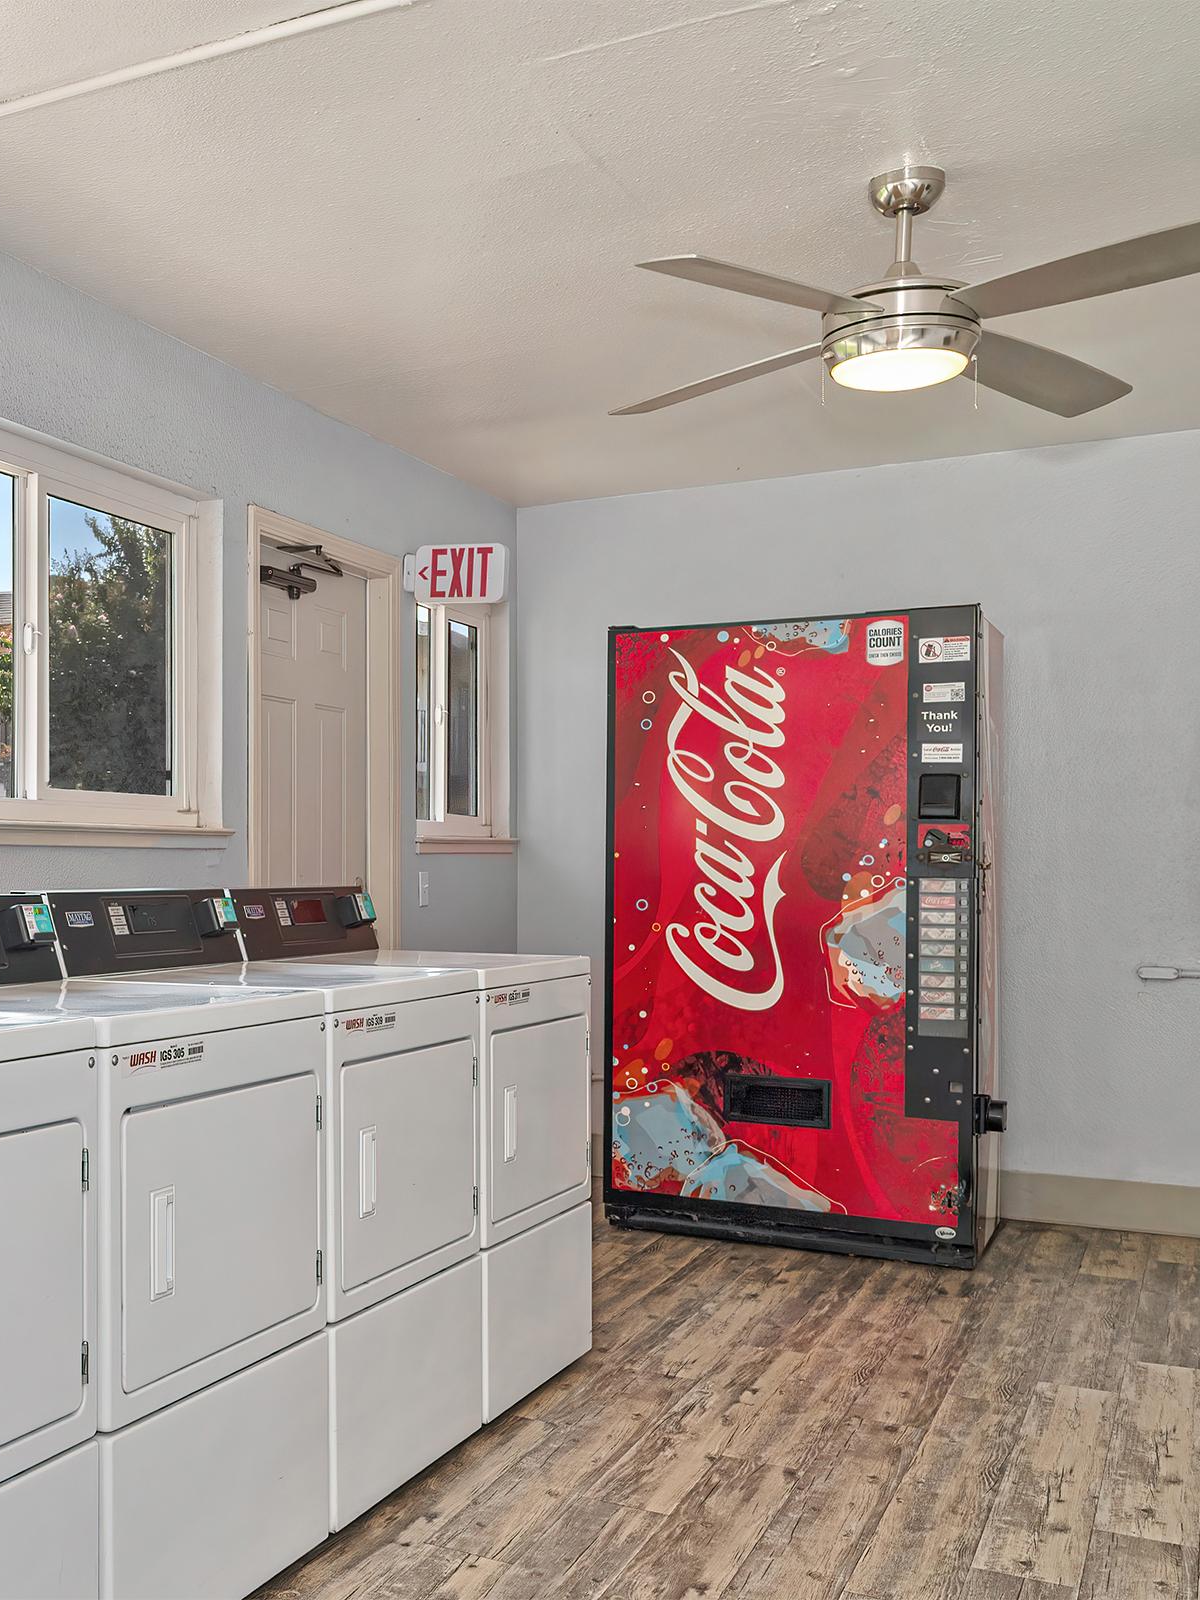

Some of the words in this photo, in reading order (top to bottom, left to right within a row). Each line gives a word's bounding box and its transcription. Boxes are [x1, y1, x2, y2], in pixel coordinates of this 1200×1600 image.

[430, 547, 493, 597] EXIT
[869, 627, 902, 637] CALORIES
[869, 636, 902, 648] COUNT
[921, 710, 958, 720] Thank
[926, 723, 952, 732] You!
[665, 647, 786, 1011] Coca-Cola
[346, 1017, 364, 1030] WASH
[130, 1050, 156, 1067] WASH
[160, 1049, 172, 1062] IGS
[173, 1047, 185, 1060] 305
